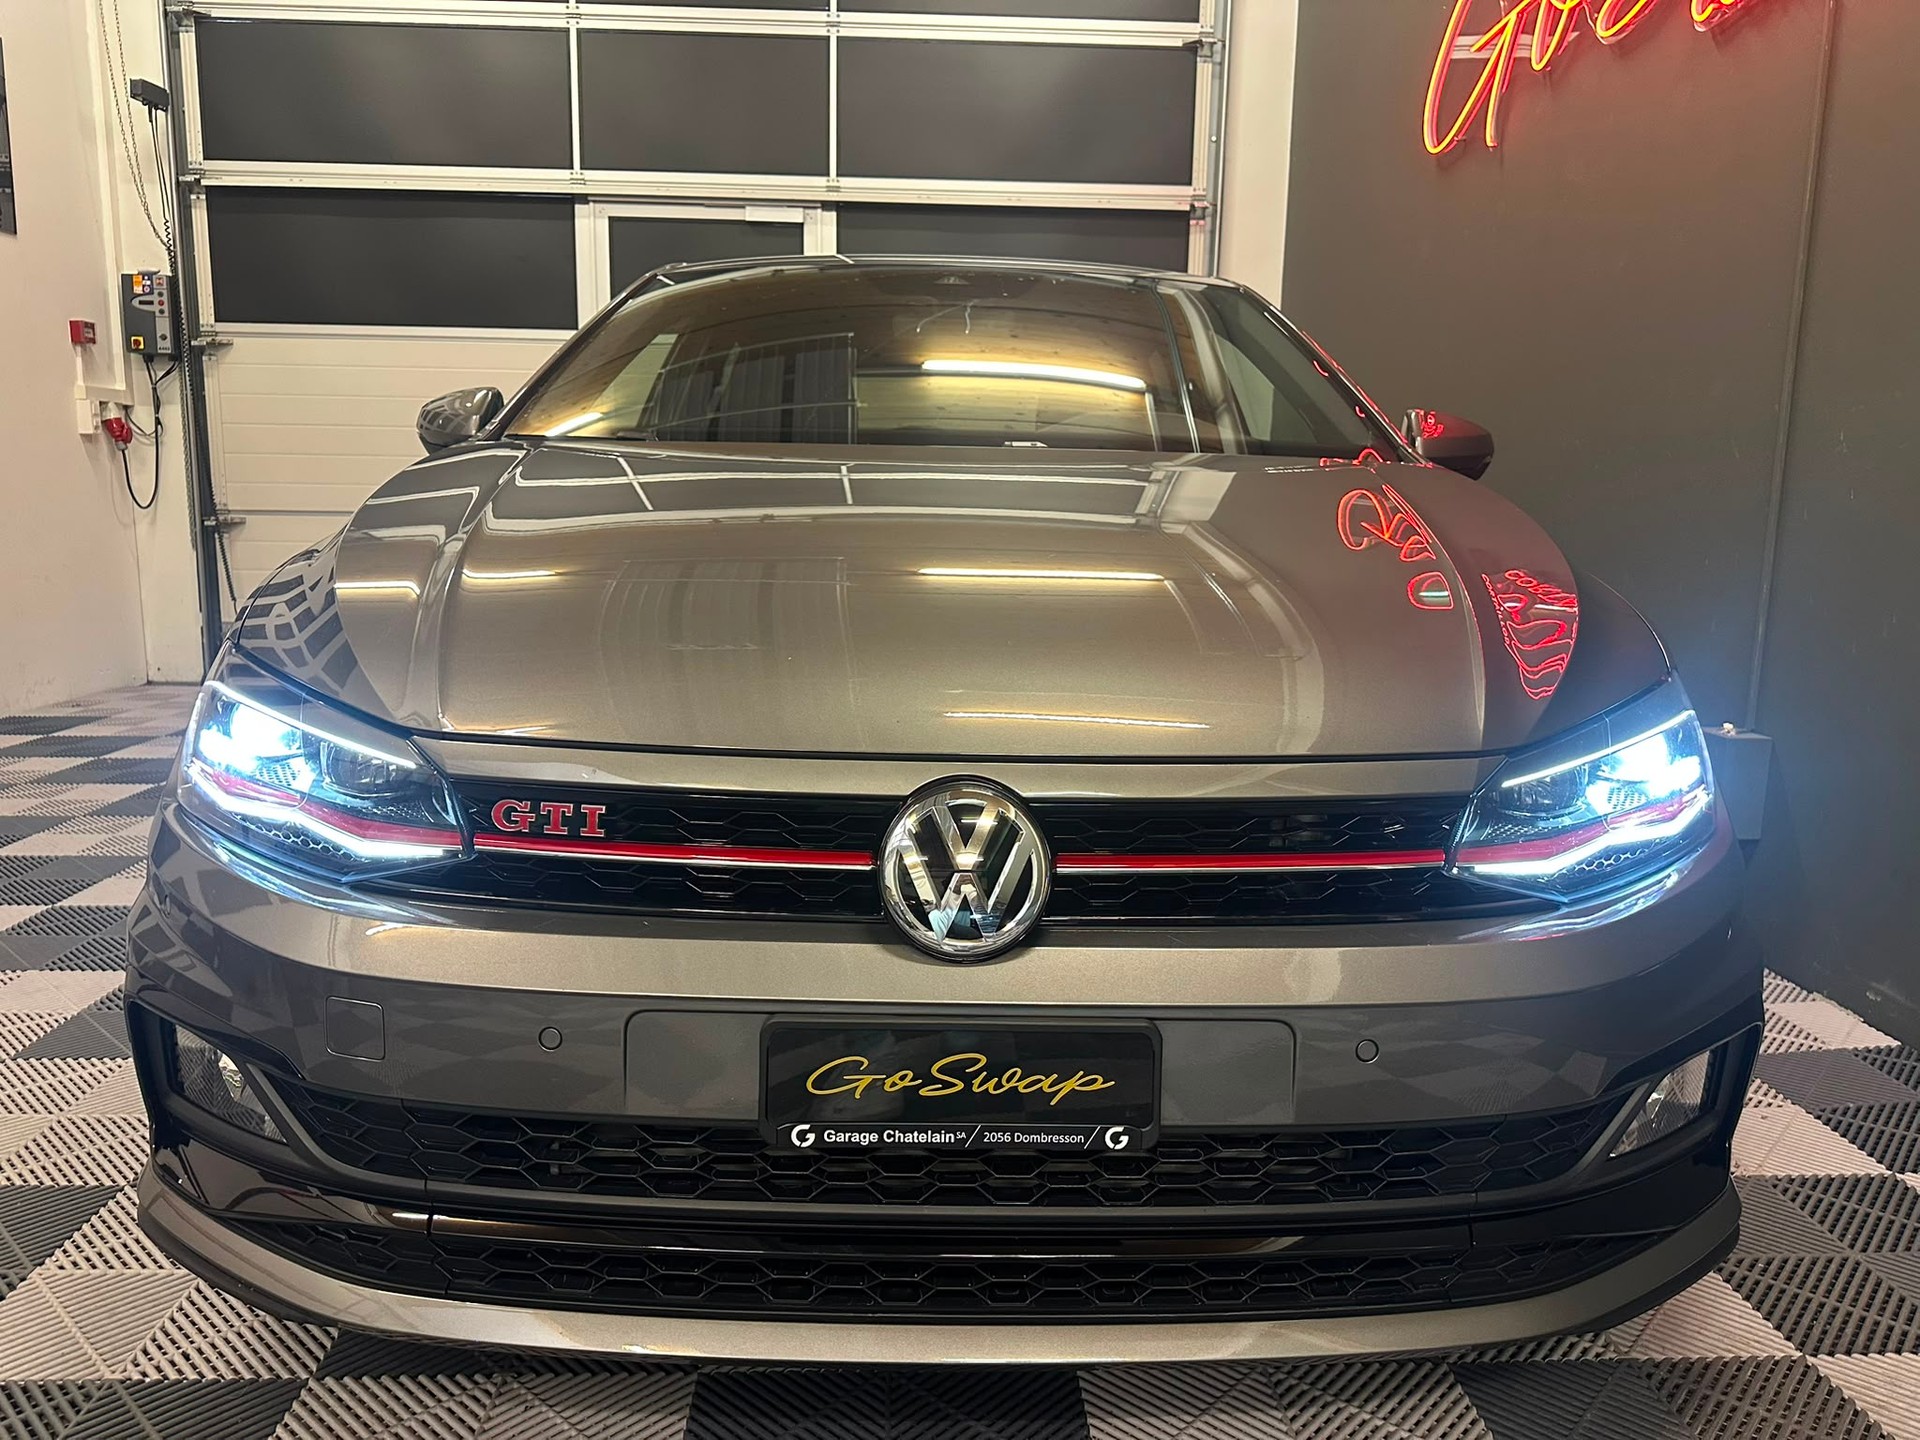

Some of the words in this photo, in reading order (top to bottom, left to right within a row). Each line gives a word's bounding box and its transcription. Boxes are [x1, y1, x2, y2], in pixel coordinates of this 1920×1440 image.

[491, 799, 606, 837] GTI
[823, 1129, 879, 1146] Garage
[983, 1132, 1011, 1143] 2056
[1014, 1132, 1085, 1144] Dombresson
